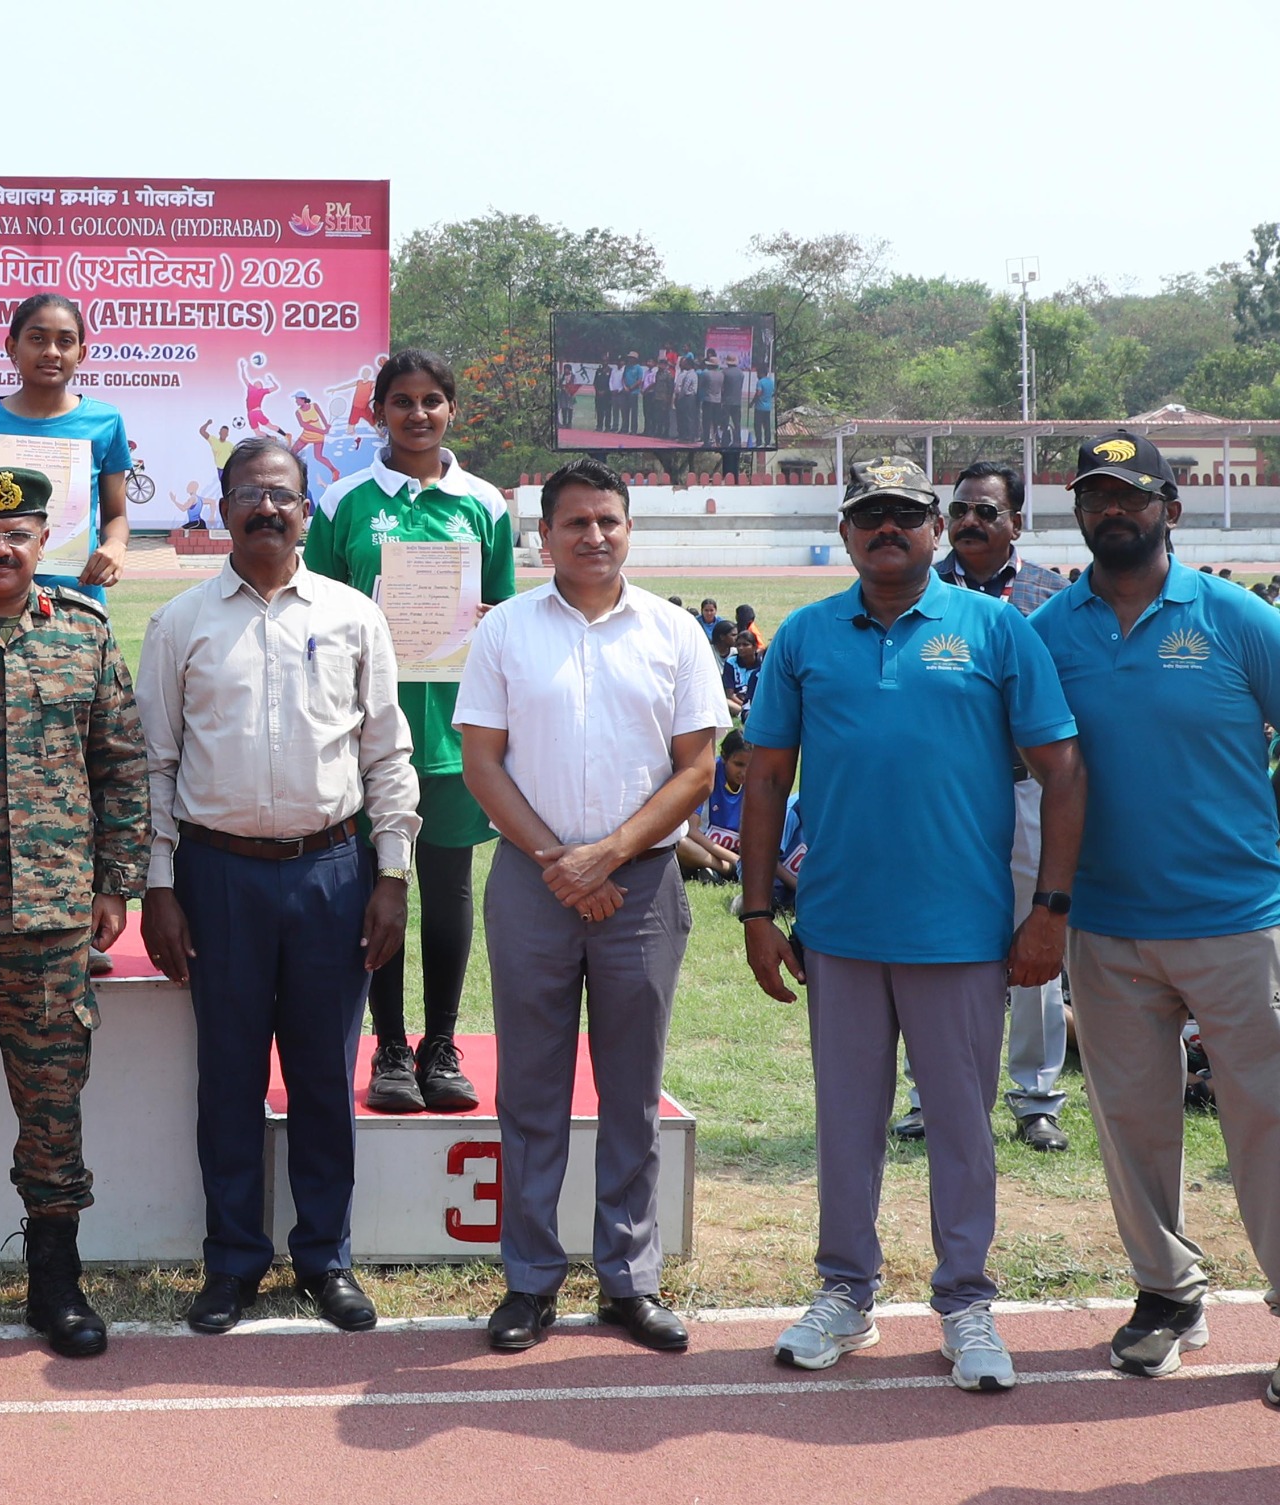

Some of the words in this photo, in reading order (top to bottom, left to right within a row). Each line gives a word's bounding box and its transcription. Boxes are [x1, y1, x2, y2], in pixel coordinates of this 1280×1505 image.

[60, 185, 118, 207] क्रमांक
[122, 190, 130, 206] 1
[135, 185, 215, 208] गोलकोंडा
[325, 203, 351, 217] PM
[25, 217, 66, 236] NO.1
[71, 217, 166, 237] GOLCONDA
[170, 218, 282, 243] (HYDERABAD)
[325, 216, 372, 232] SHRI
[241, 260, 323, 288] 2026
[89, 301, 275, 333] (ATHLETICS)
[283, 304, 358, 329] 2026
[90, 345, 197, 361] 29.04.2026
[104, 374, 181, 387] GOLCONDA
[446, 1141, 503, 1243] 3
